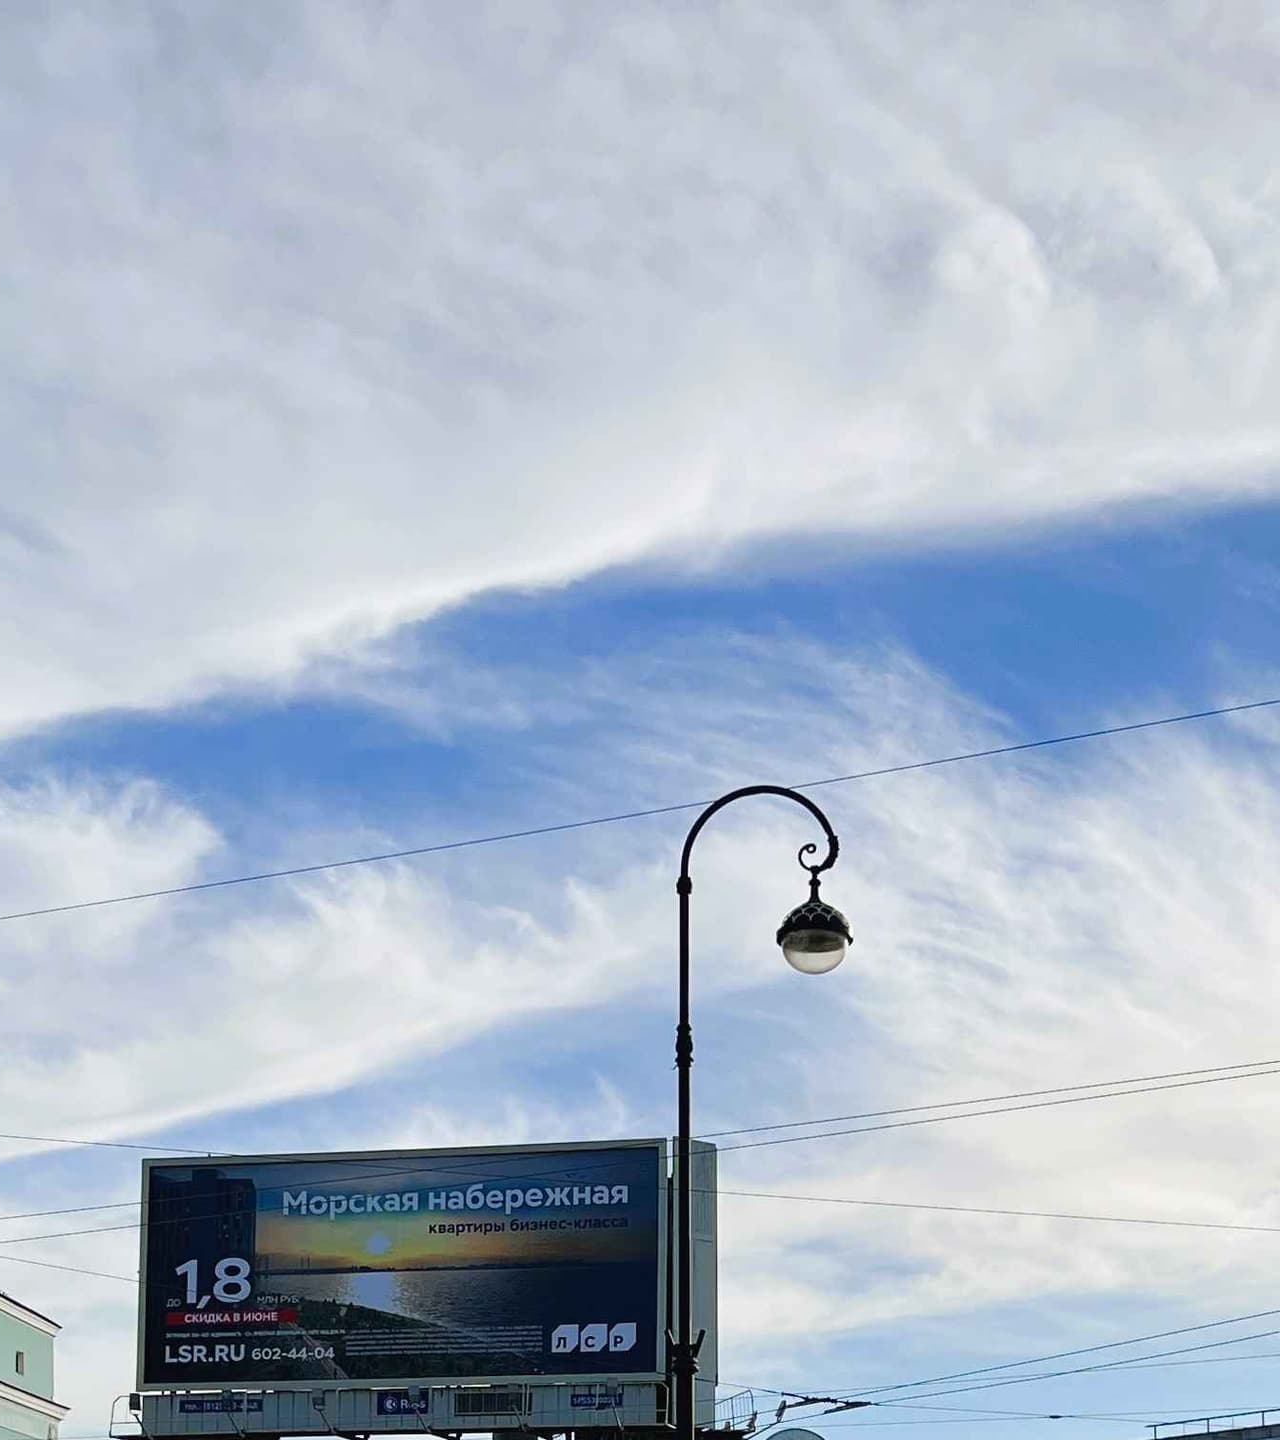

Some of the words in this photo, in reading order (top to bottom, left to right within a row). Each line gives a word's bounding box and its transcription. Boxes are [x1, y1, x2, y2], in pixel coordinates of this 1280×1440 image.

[282, 1190, 419, 1220] Морская
[427, 1183, 629, 1215] набережная
[428, 1220, 505, 1237] квартиры
[509, 1216, 629, 1233] бизнес-класса
[175, 1257, 252, 1310] 1,8
[184, 1312, 231, 1324] СКИДКА
[233, 1313, 240, 1323] В
[243, 1311, 278, 1322] ИЮНЕ
[164, 1343, 247, 1364] LSR.RU
[251, 1346, 336, 1361] 602-44-04
